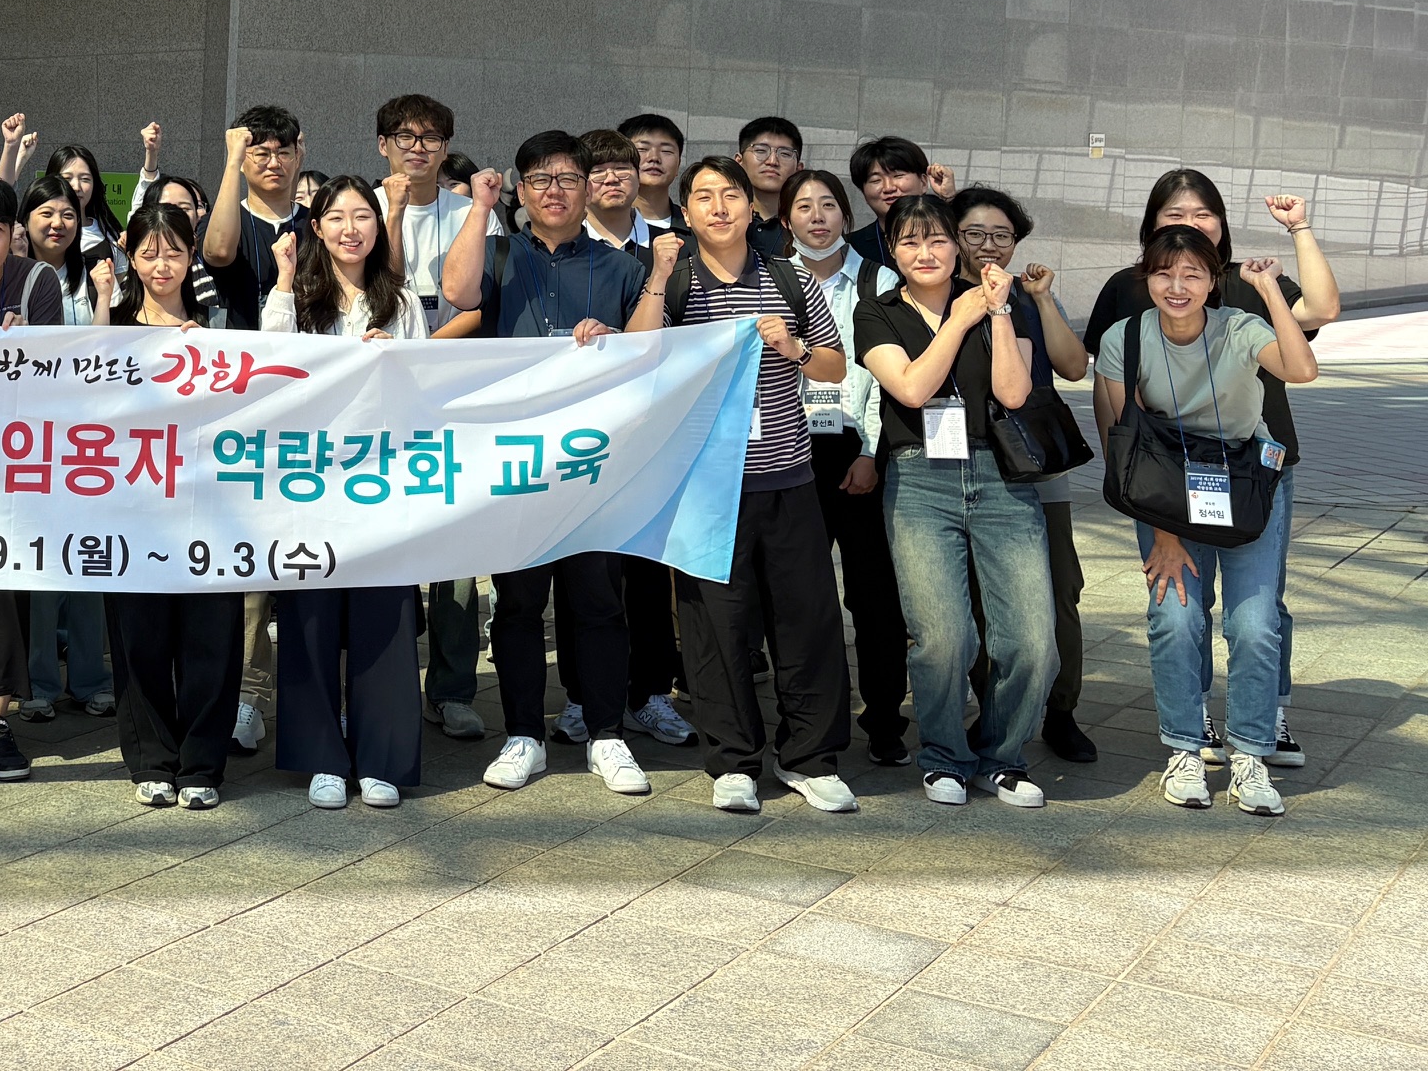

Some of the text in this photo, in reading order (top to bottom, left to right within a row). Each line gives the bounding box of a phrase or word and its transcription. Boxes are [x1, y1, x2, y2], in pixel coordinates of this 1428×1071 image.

[73, 355, 144, 386] 만드는
[151, 344, 310, 396] 강화
[1, 420, 184, 499] 임용자
[212, 428, 463, 505] 역량강화
[490, 427, 611, 498] 교육
